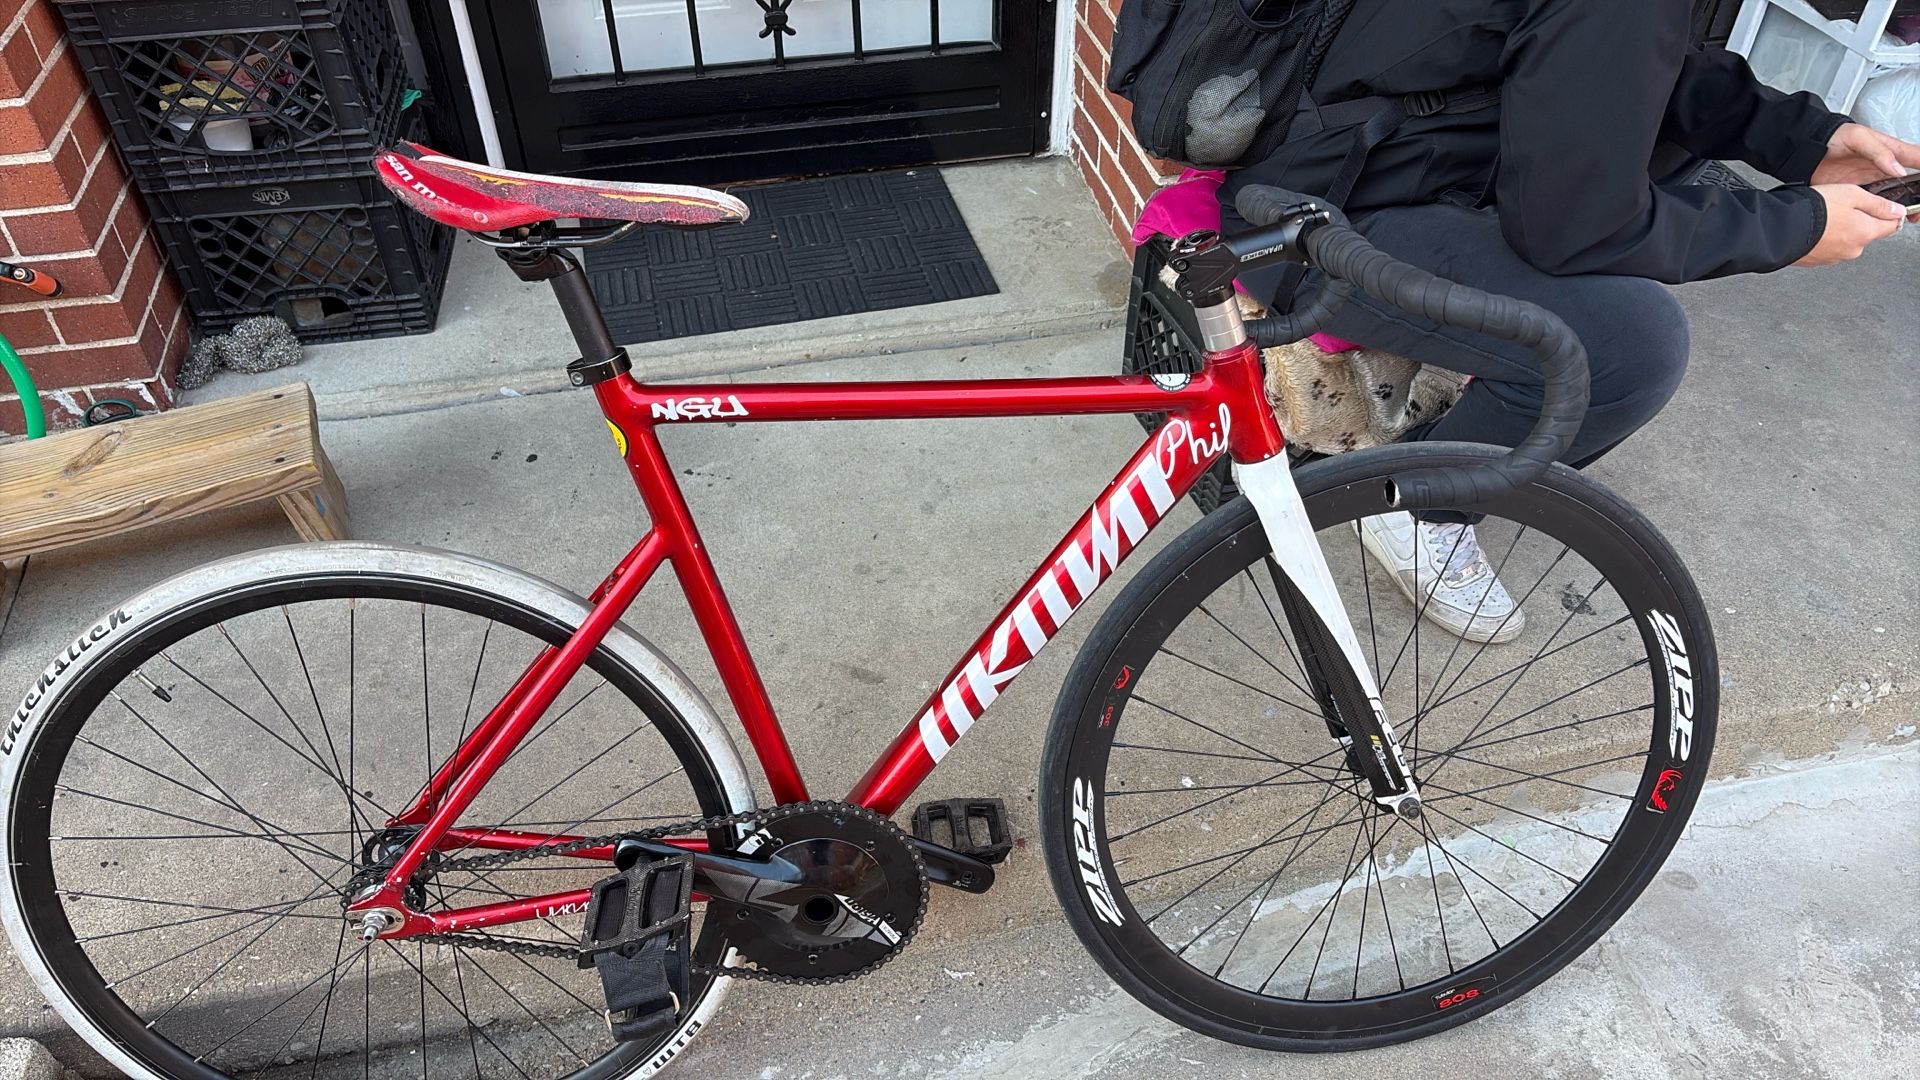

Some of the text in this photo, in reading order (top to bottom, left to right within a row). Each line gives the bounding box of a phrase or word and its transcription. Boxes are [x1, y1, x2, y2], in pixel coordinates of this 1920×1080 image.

[384, 155, 414, 182] san
[1155, 402, 1231, 480] Phil
[1650, 608, 1694, 762] ZIPP
[1073, 776, 1124, 927] ZIPP
[652, 1019, 702, 1070] WTB
